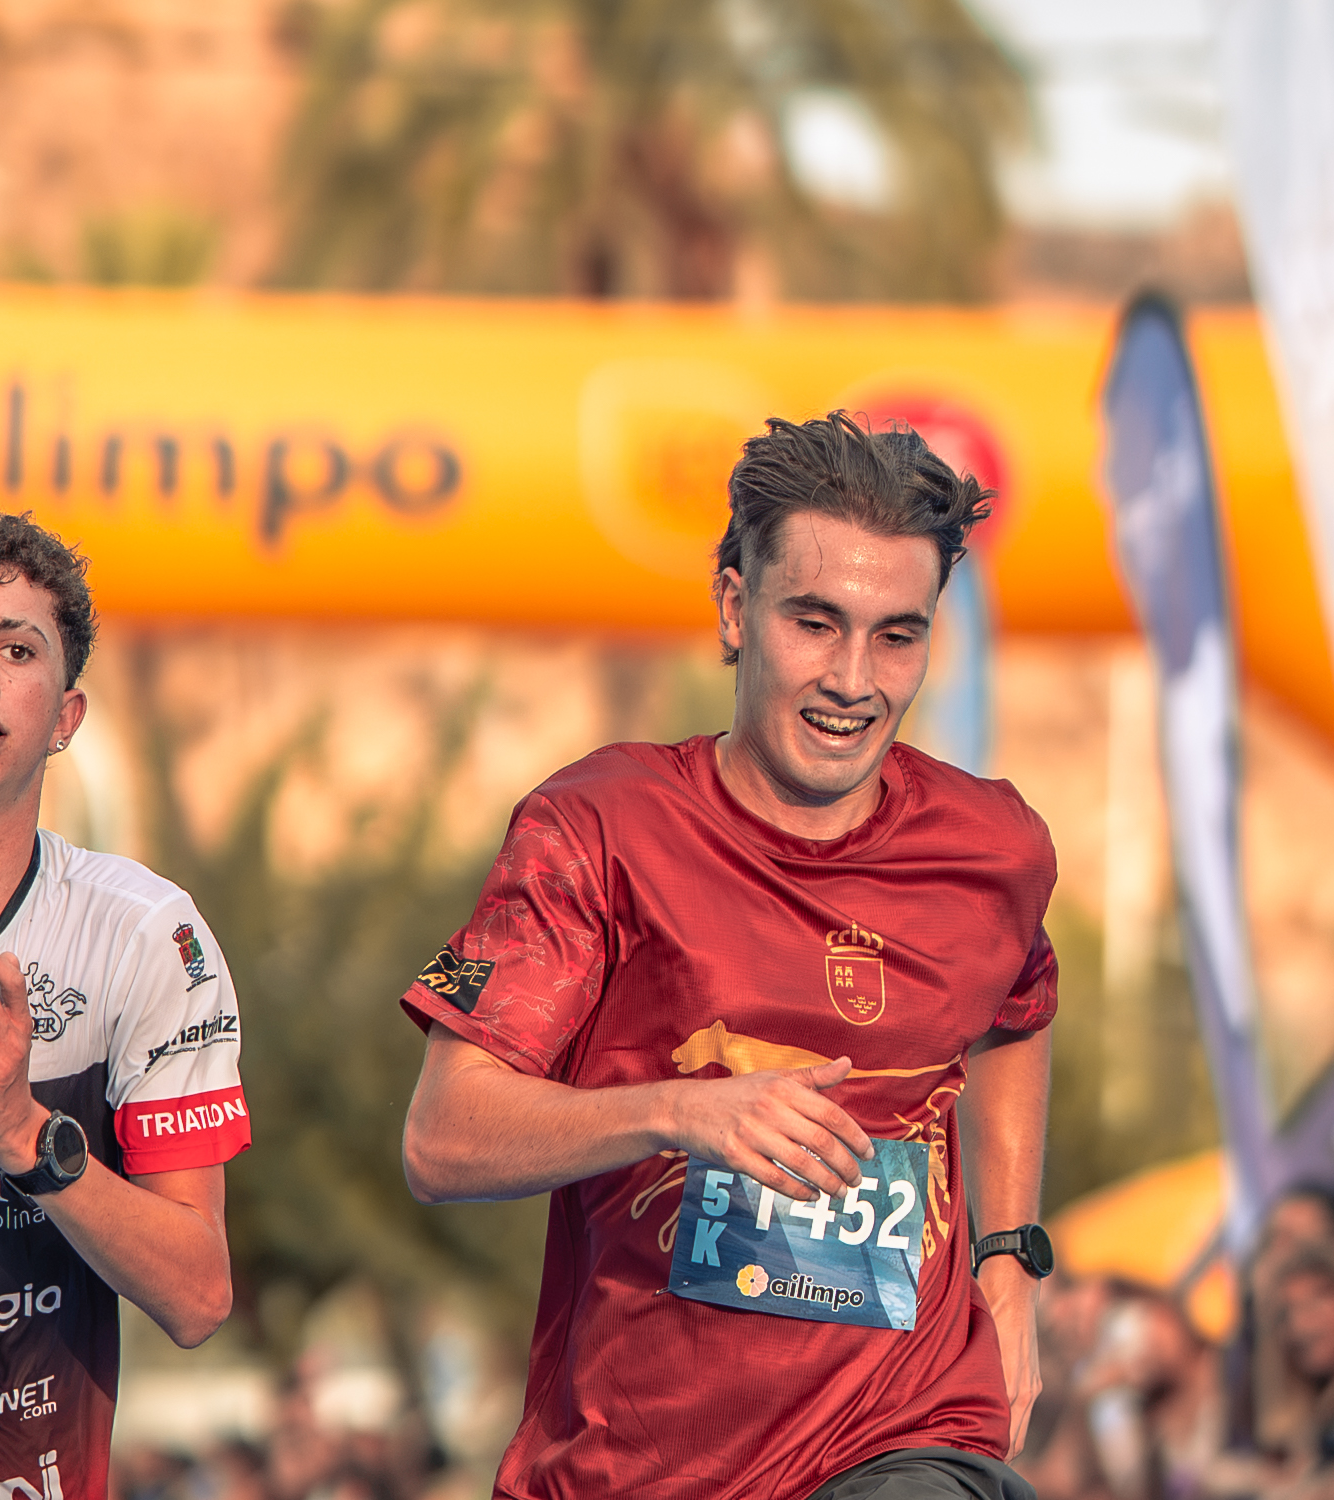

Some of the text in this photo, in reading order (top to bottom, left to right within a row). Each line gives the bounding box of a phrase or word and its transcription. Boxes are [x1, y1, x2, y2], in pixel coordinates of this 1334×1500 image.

[137, 1098, 247, 1138] TRIATLON
[701, 1169, 734, 1217] 5
[751, 1176, 917, 1251] 1452
[690, 1217, 728, 1267] K
[770, 1273, 865, 1312] ailimpo
[19, 1401, 58, 1422] .com
